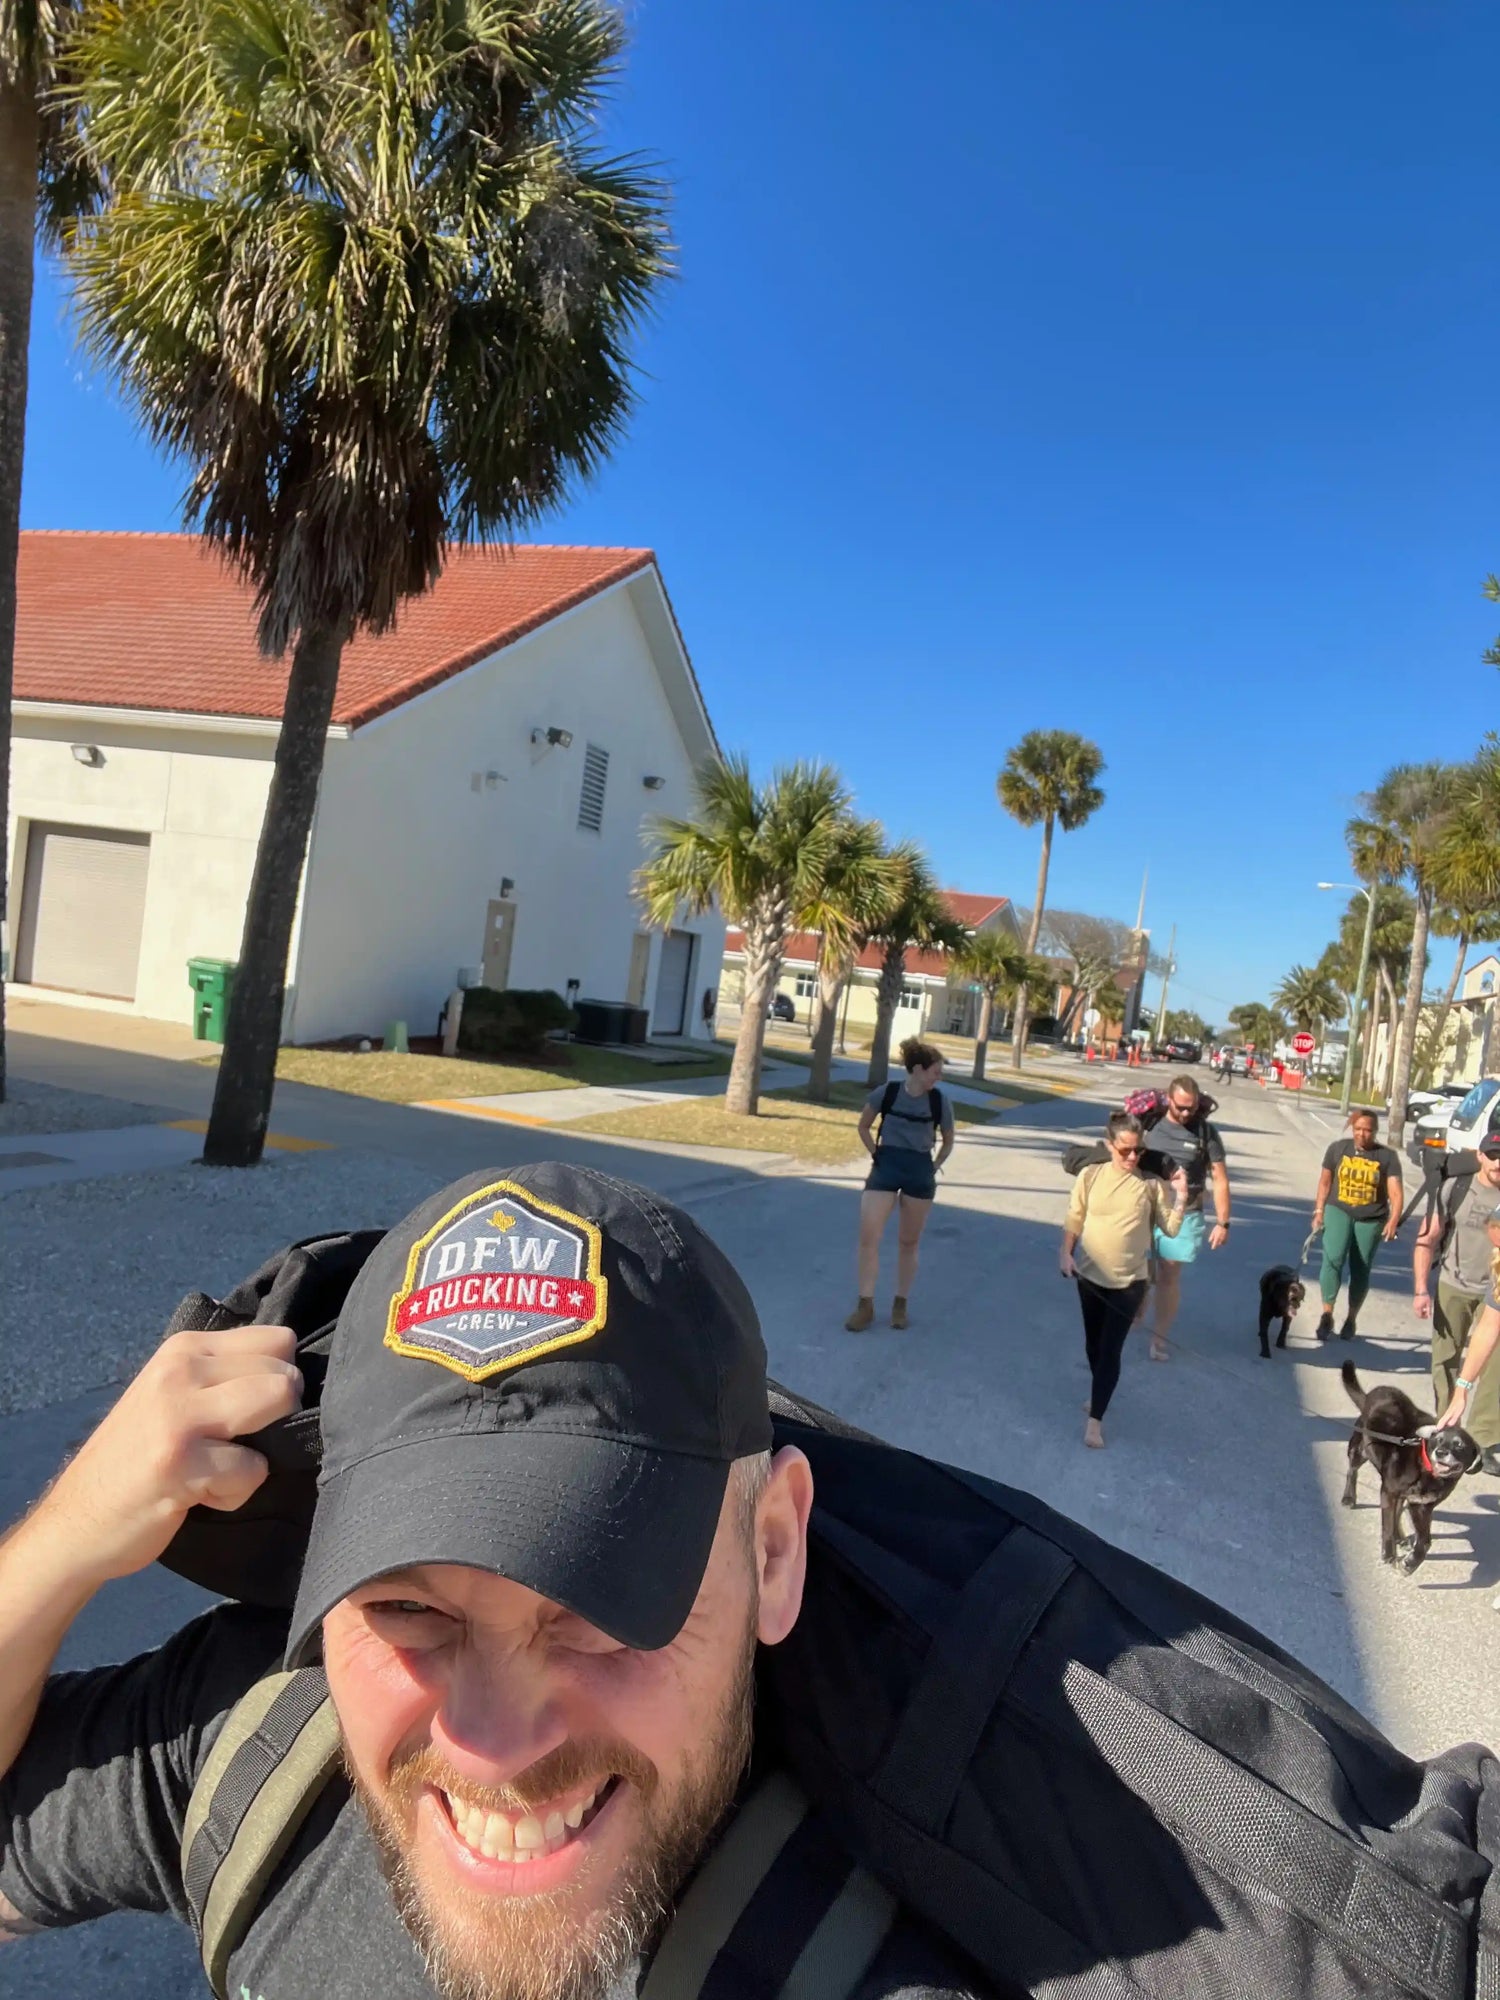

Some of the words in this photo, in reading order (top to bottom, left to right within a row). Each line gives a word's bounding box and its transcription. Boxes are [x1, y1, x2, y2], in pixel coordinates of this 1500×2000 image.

[1293, 1038, 1314, 1049] STOP
[436, 1236, 560, 1280] DFW
[426, 1277, 559, 1315] RUCKING
